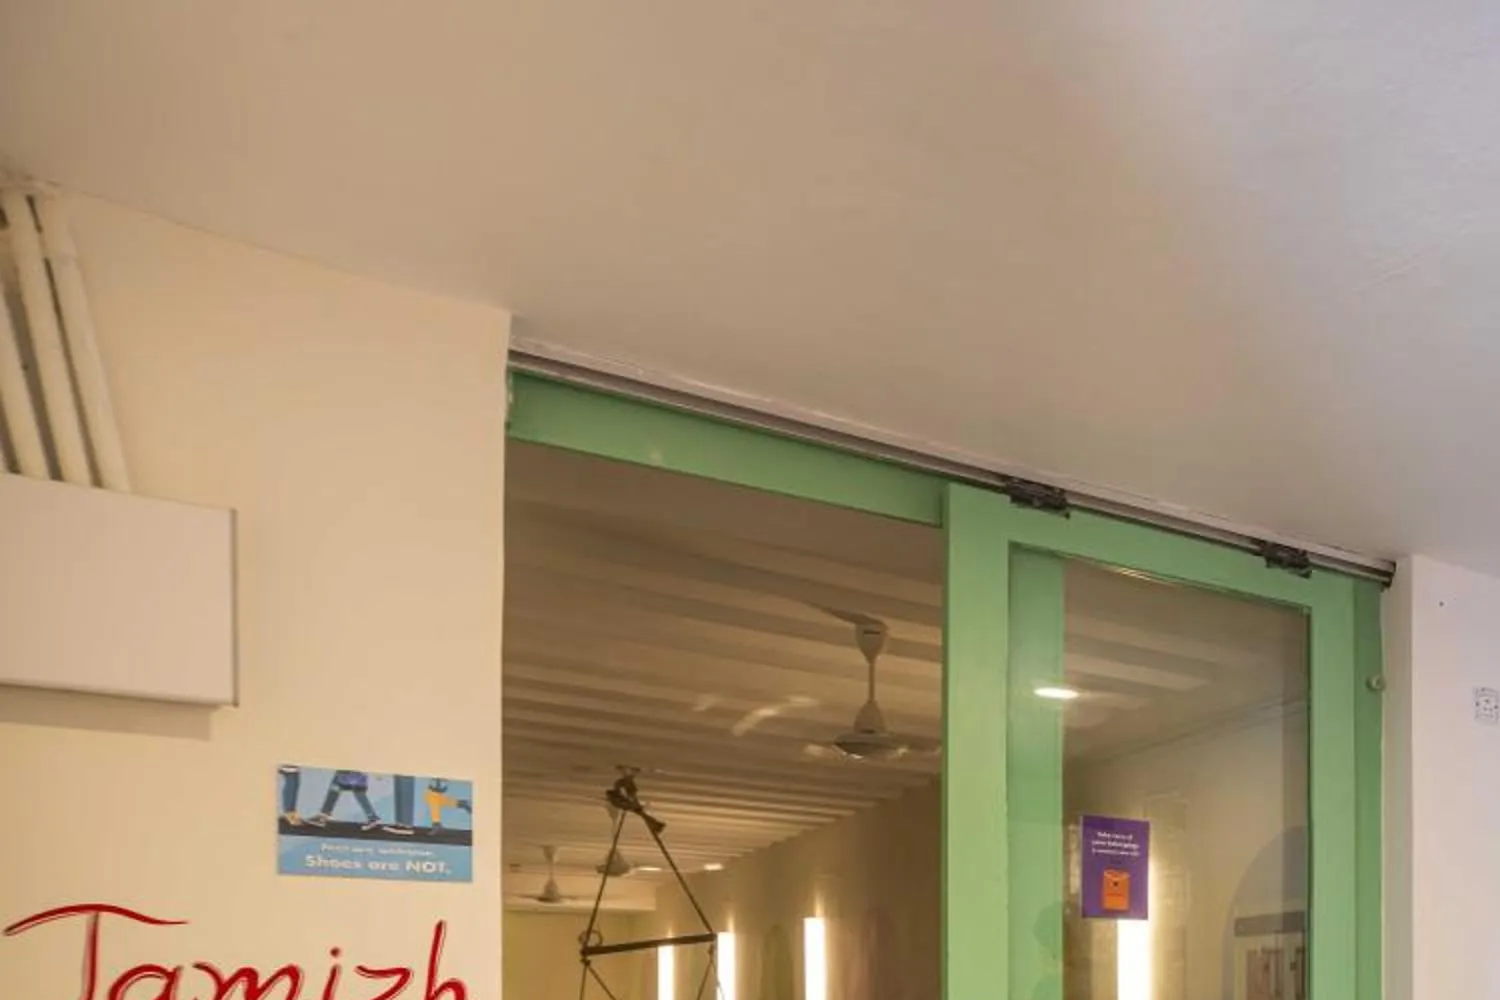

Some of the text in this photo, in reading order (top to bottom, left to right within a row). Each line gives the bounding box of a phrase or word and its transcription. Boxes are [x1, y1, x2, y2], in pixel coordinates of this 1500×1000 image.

[305, 854, 452, 876] Shoes are NOT.
